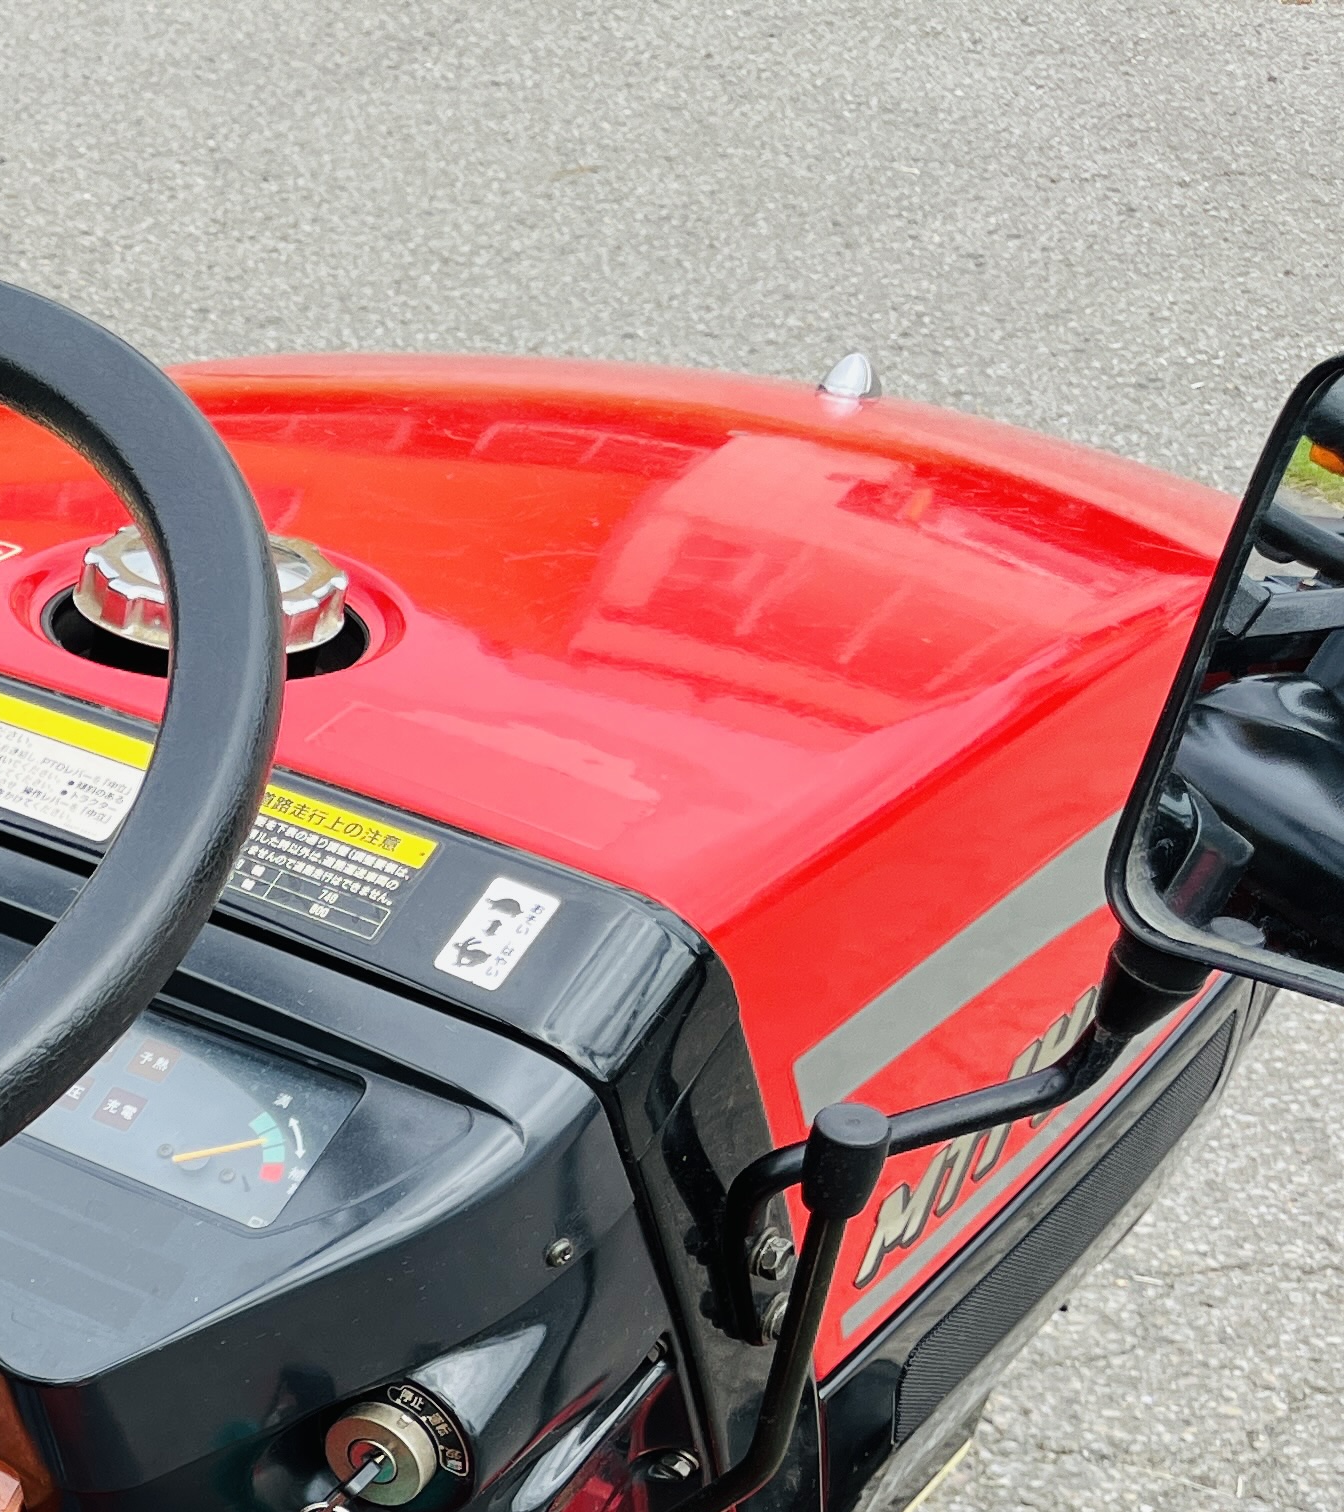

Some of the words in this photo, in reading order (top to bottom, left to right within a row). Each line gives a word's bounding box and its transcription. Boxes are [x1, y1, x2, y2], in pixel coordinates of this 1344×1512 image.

[515, 903, 546, 936] おそい
[485, 945, 515, 979] はやい
[139, 1051, 170, 1072] 予熱
[65, 1084, 87, 1102] 圧
[103, 1098, 139, 1122] 充電
